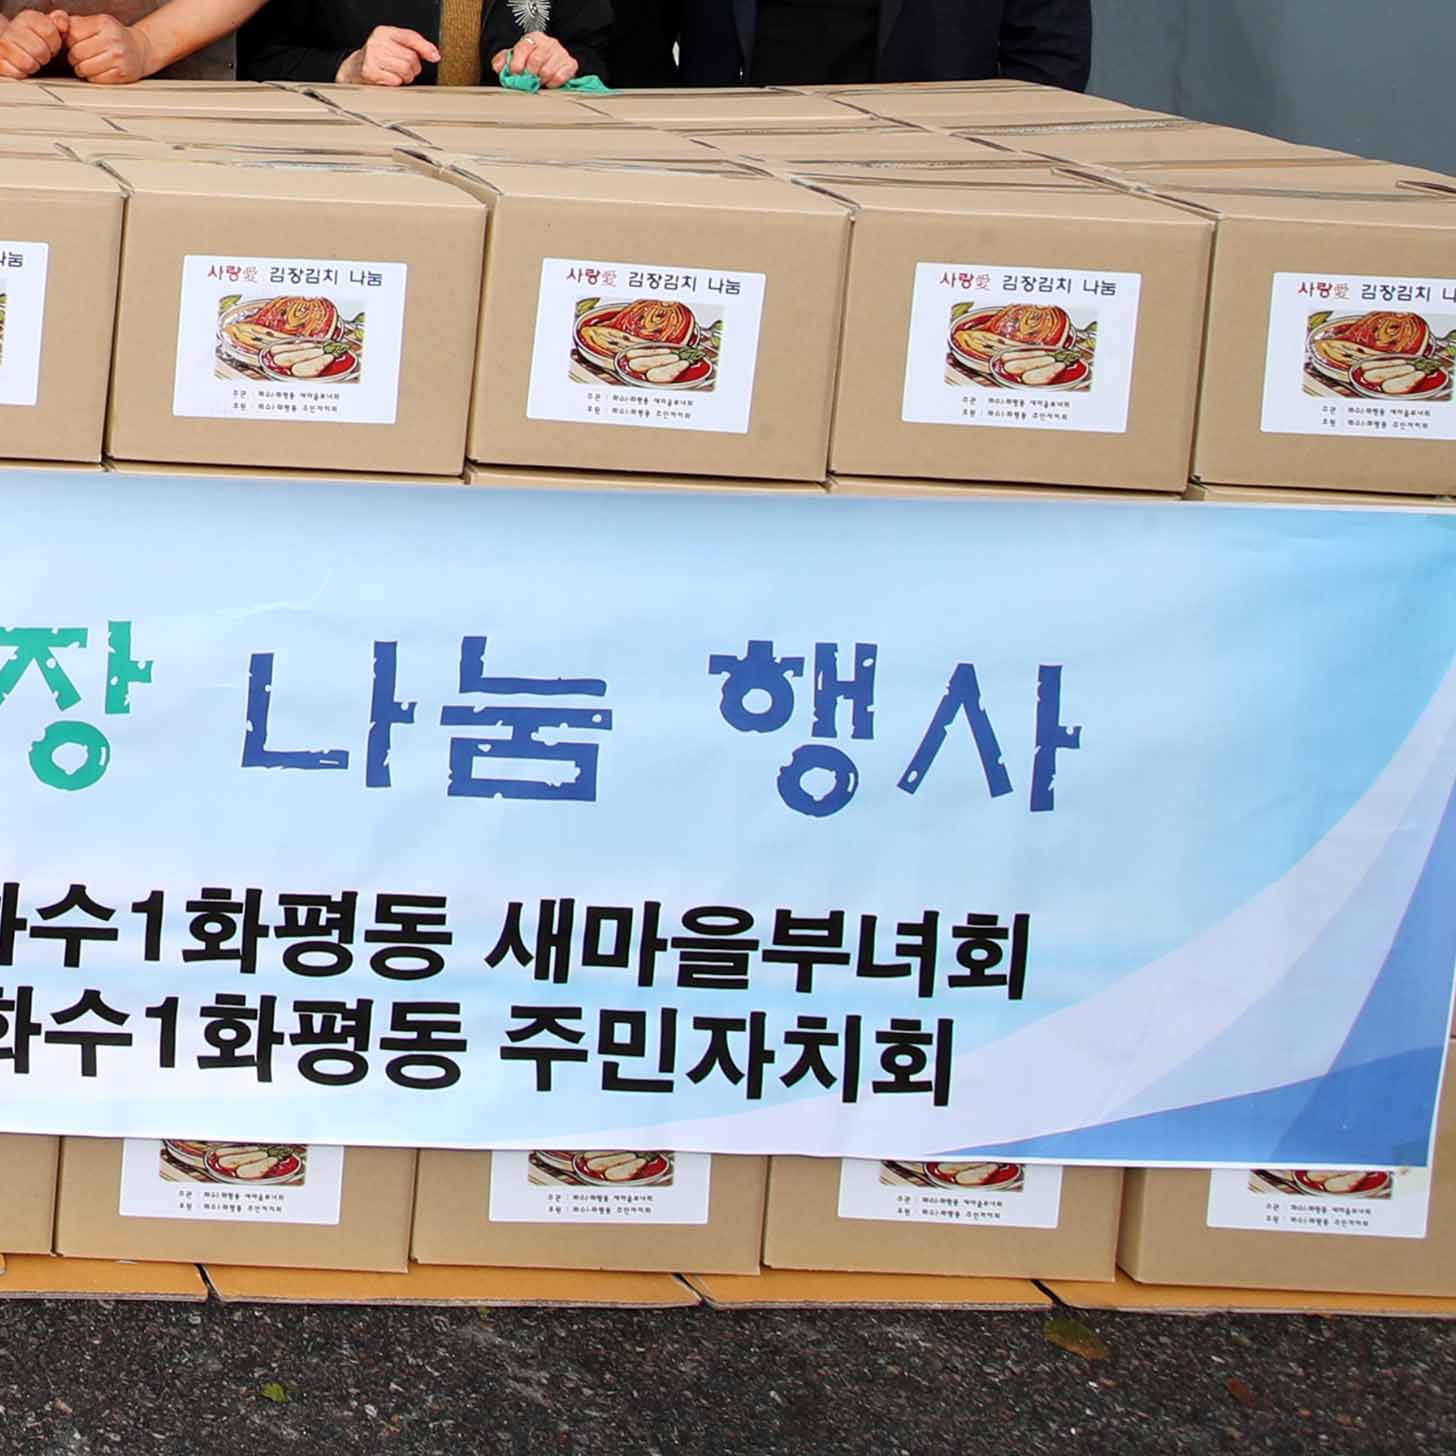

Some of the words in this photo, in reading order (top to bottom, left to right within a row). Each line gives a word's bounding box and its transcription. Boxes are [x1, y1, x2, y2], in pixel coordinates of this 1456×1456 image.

[269, 266, 339, 286] 김장김치
[349, 269, 383, 287] 나눔
[628, 271, 698, 293] 김장김치
[707, 277, 742, 296] 나눔
[1002, 274, 1072, 295] 김장김치
[1082, 279, 1117, 297] 나눔
[1361, 283, 1431, 303] 김장김치
[240, 634, 614, 804] 나눔
[708, 638, 1083, 819] 행사
[484, 895, 1032, 1001] 새마을부녀회
[498, 1000, 956, 1107] 주민자치회
